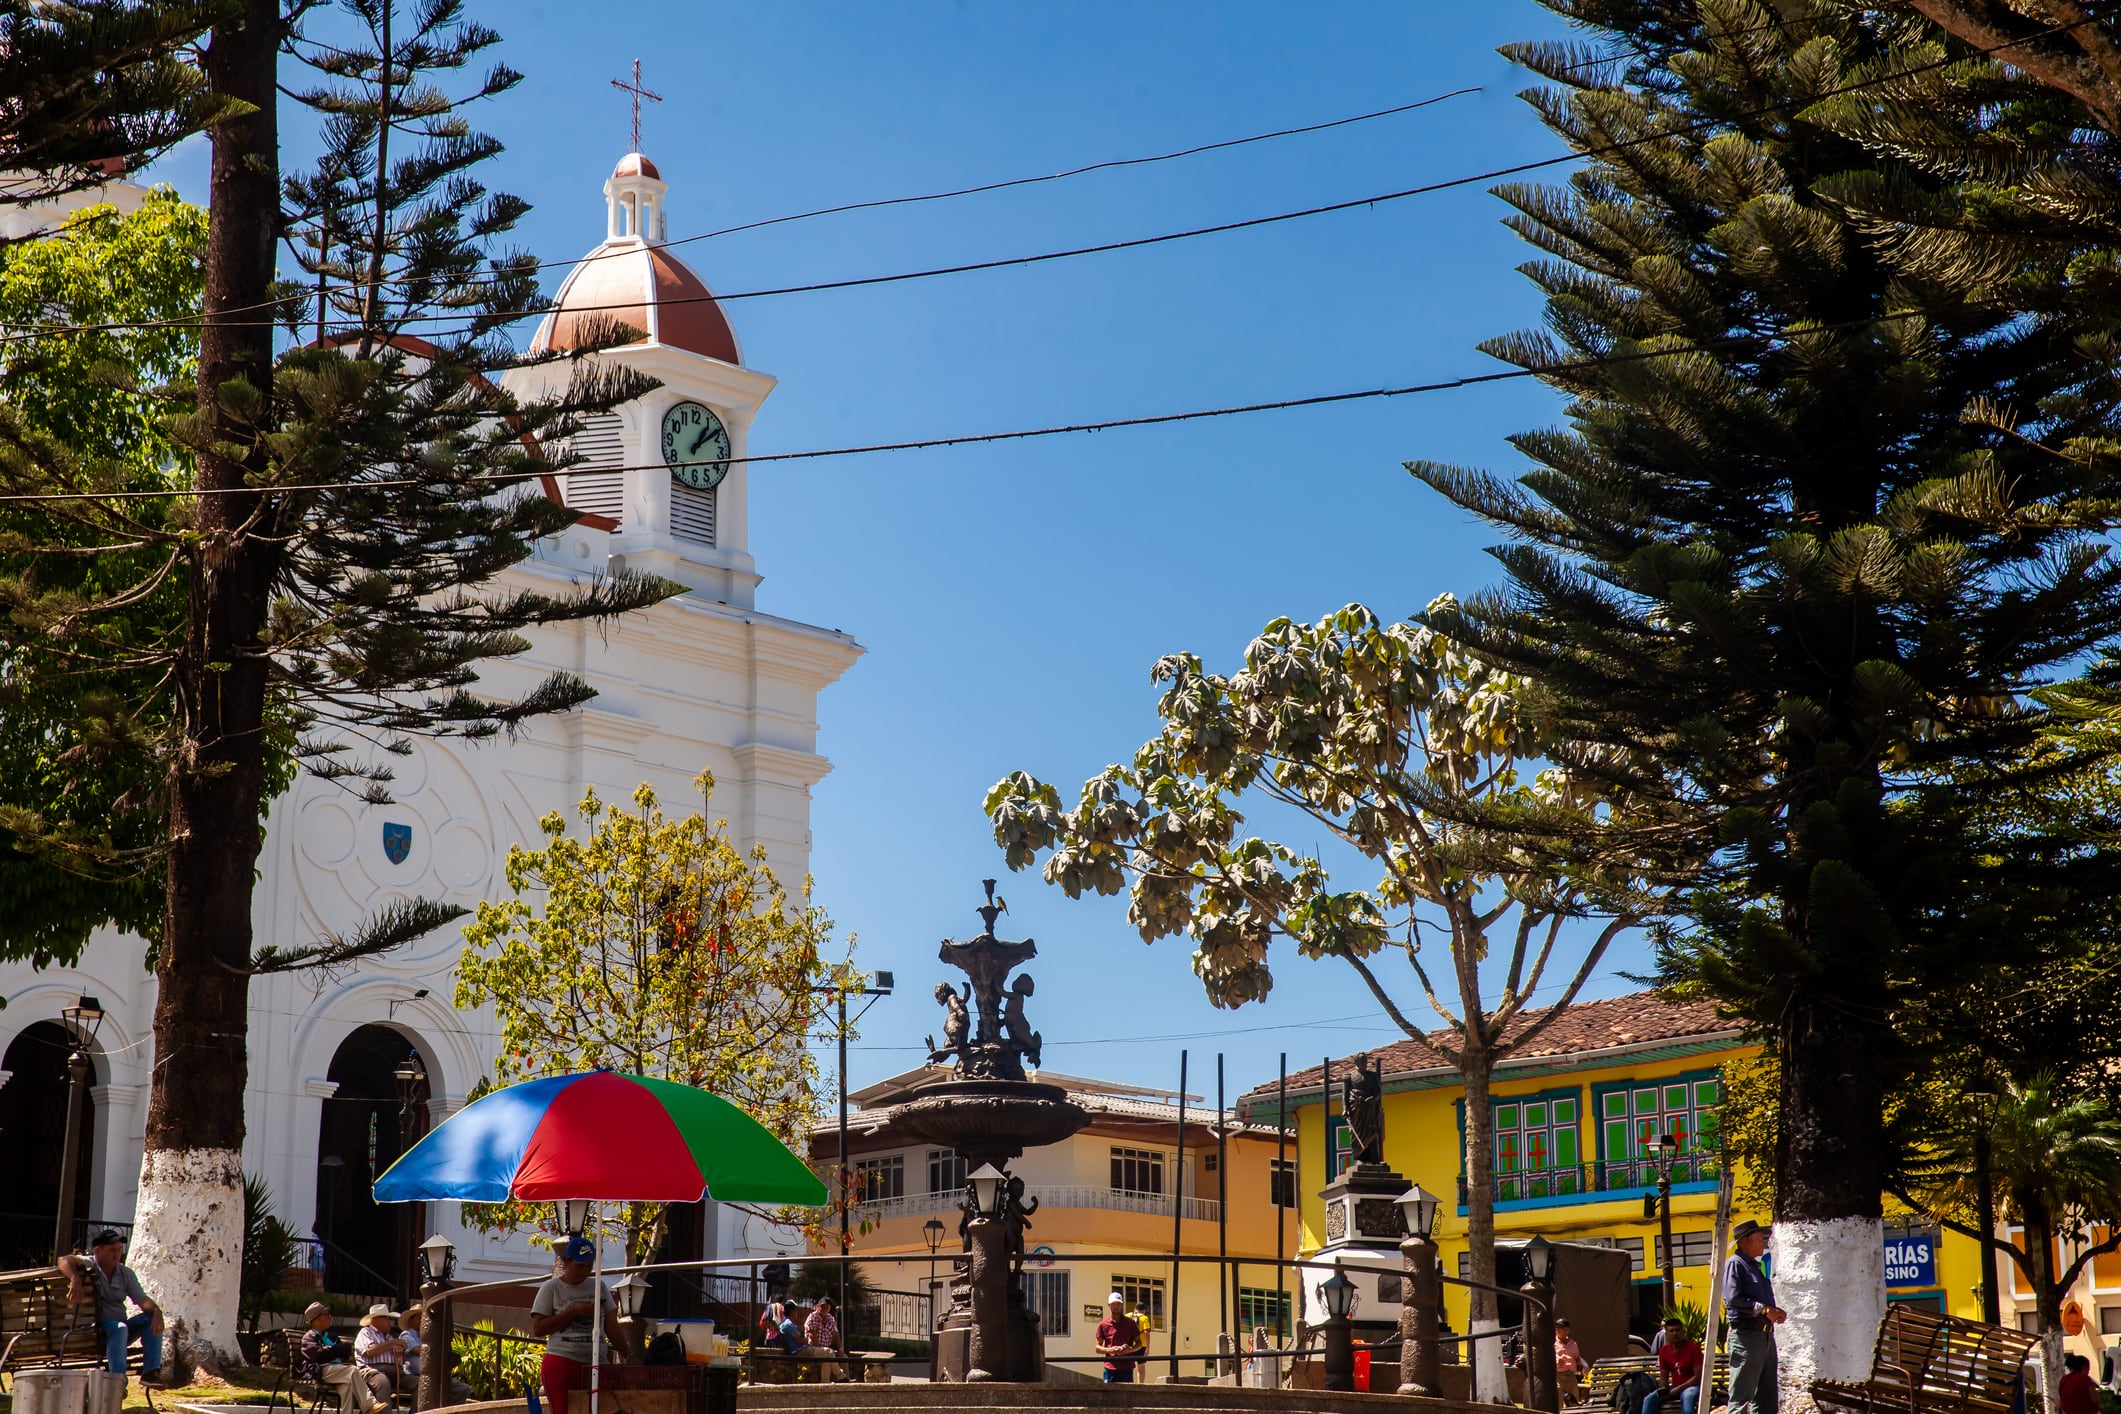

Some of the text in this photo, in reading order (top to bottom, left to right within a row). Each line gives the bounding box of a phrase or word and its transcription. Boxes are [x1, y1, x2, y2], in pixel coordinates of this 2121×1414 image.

[680, 410, 688, 426] 11
[691, 409, 701, 425] 12
[671, 418, 681, 434] 10
[667, 433, 674, 447] 9
[714, 429, 720, 443] 2
[670, 449, 677, 462] 8
[717, 446, 724, 460] 3
[691, 469, 698, 483] 6
[703, 468, 710, 483] 5
[1885, 1241, 1929, 1265] RÍAS
[1886, 1265, 1919, 1280] SINO
